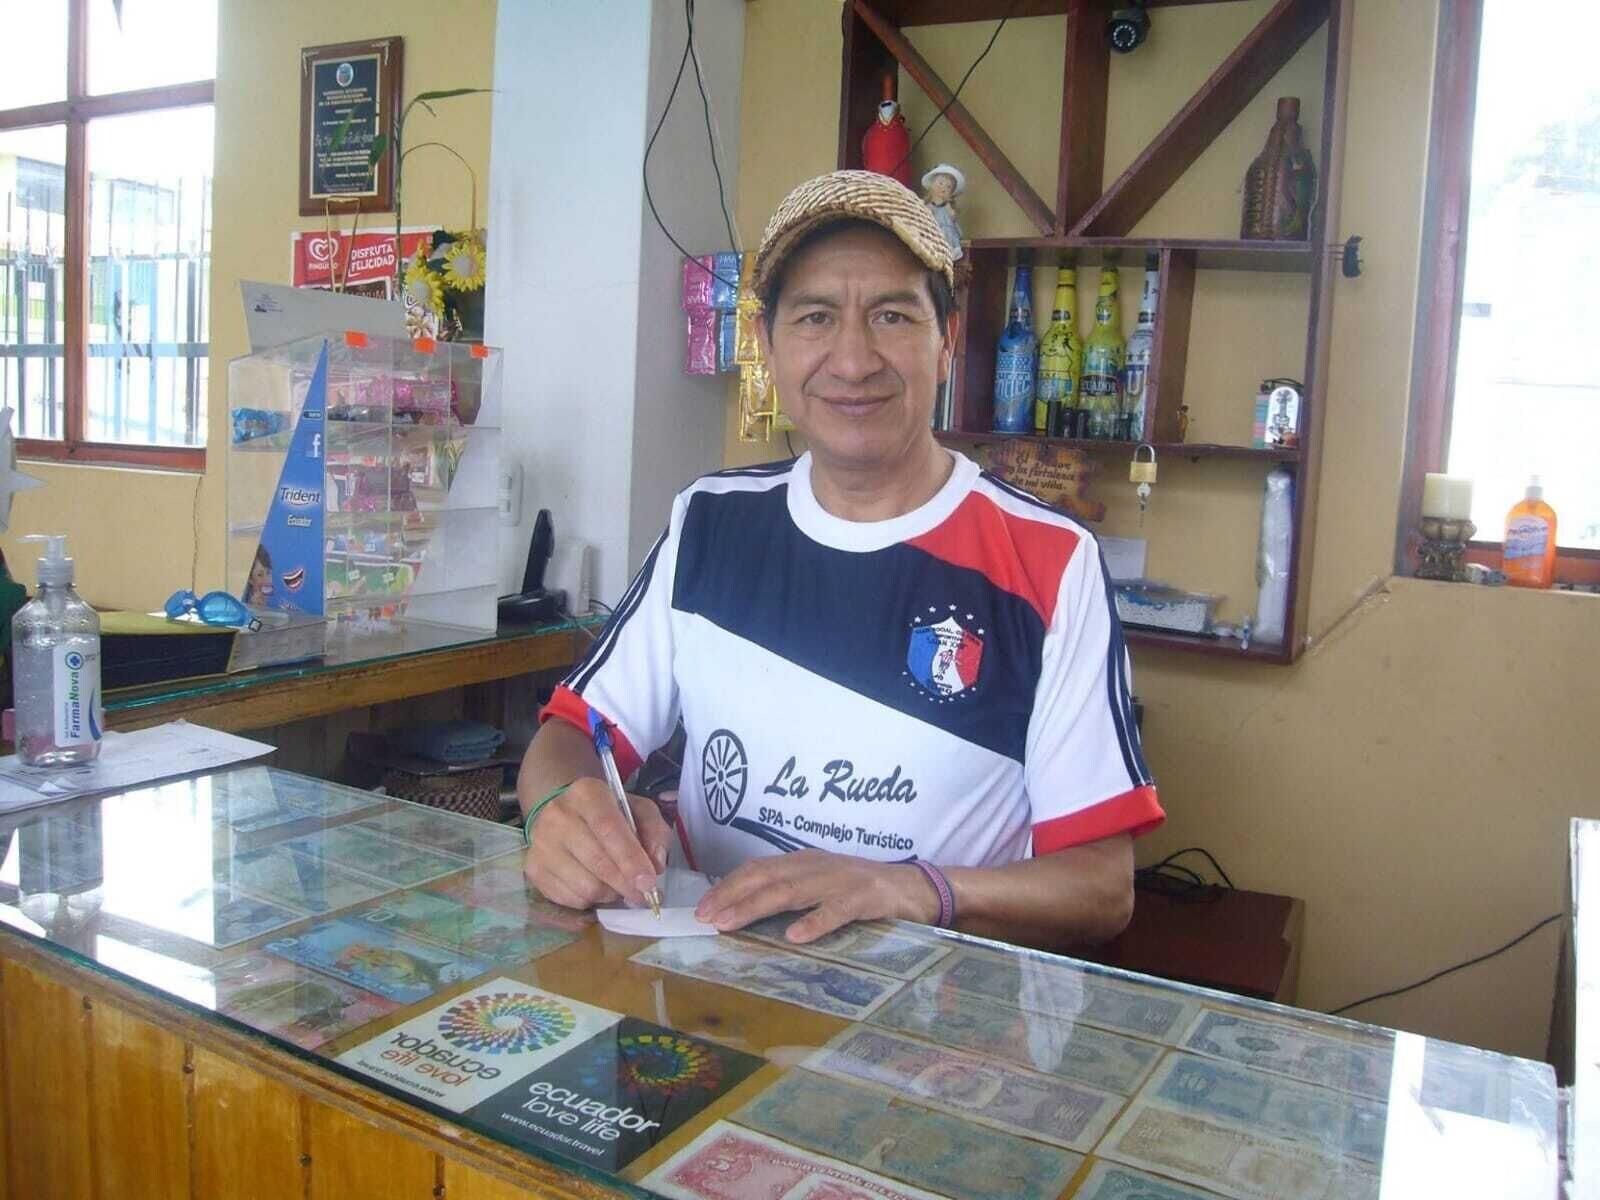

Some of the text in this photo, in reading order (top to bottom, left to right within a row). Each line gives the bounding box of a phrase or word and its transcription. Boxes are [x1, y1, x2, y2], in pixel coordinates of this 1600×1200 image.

[351, 255, 395, 272] FELICIDAD
[352, 244, 393, 259] DISFRUTA
[280, 487, 320, 503] Trident
[70, 670, 80, 739] FarmaNova
[763, 756, 918, 804] La Rueda
[793, 814, 854, 844] Complejo
[855, 827, 914, 851] Turístico
[521, 1096, 621, 1141] love life
[528, 1081, 661, 1133] ecuador
[501, 1112, 606, 1157] www.ecuador.travel
